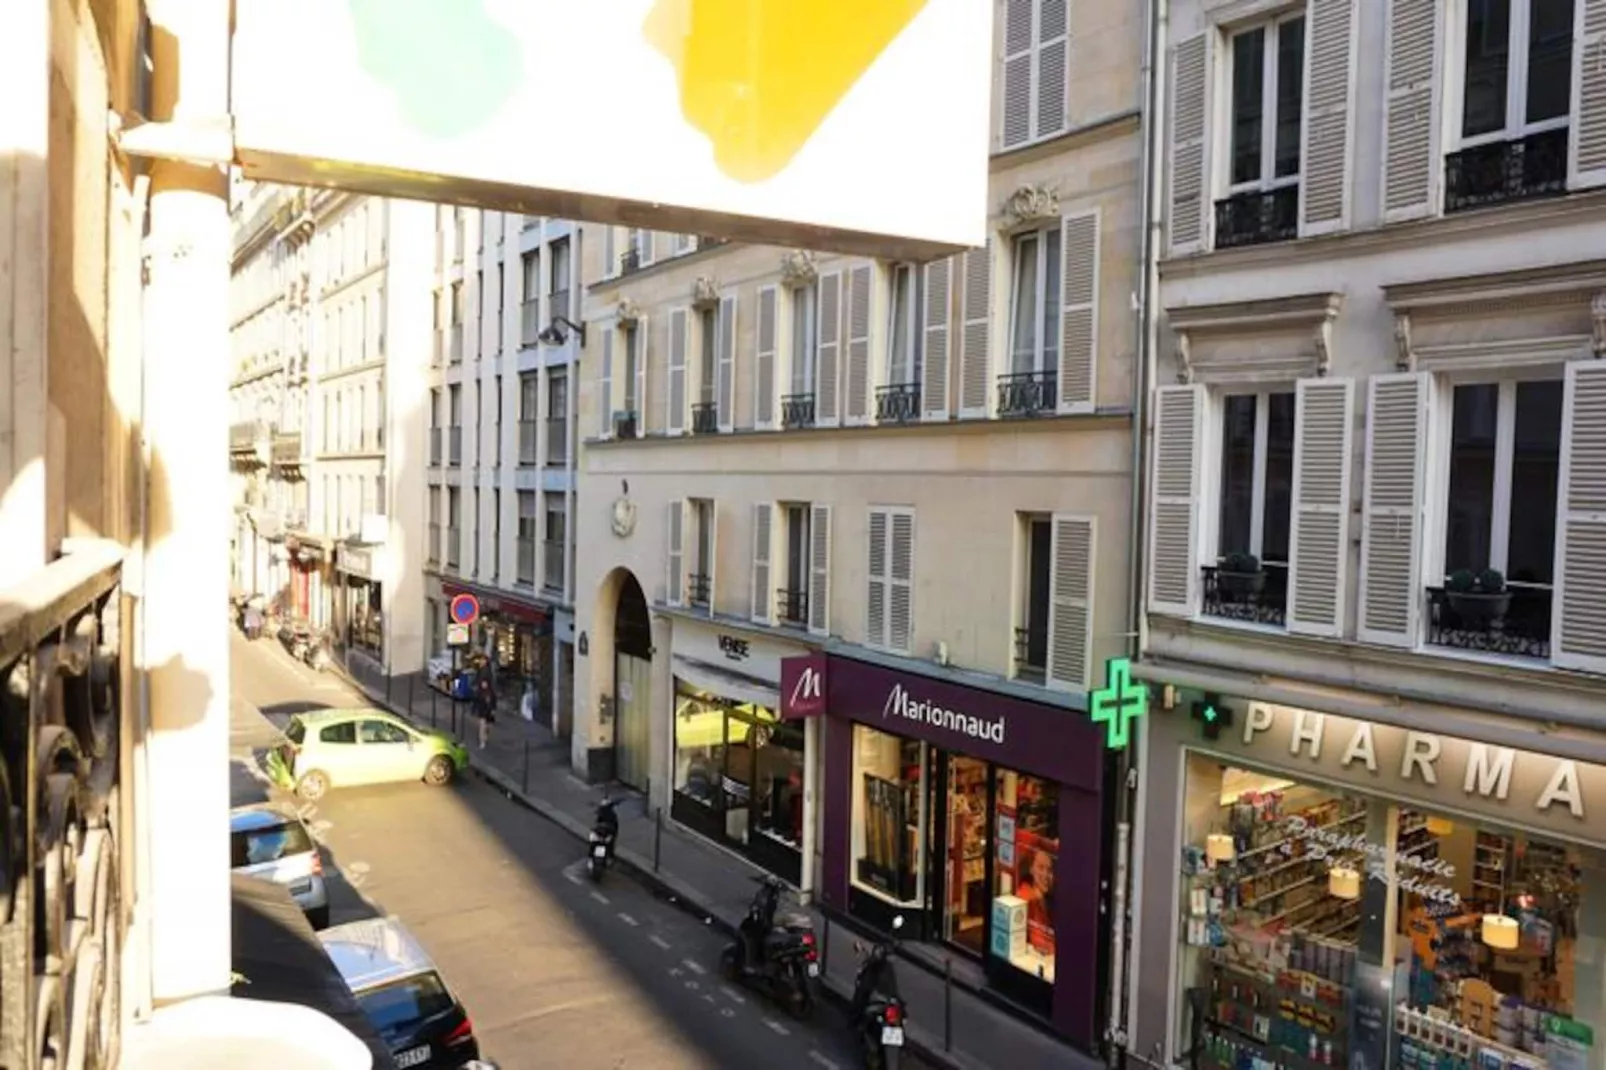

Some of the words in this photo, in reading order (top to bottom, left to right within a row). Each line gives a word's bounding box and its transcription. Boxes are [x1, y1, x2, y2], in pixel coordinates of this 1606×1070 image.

[790, 667, 821, 708] M
[883, 683, 1004, 743] Marionnaud
[1243, 701, 1584, 817] PHARMA
[1368, 860, 1460, 905] Rduits
